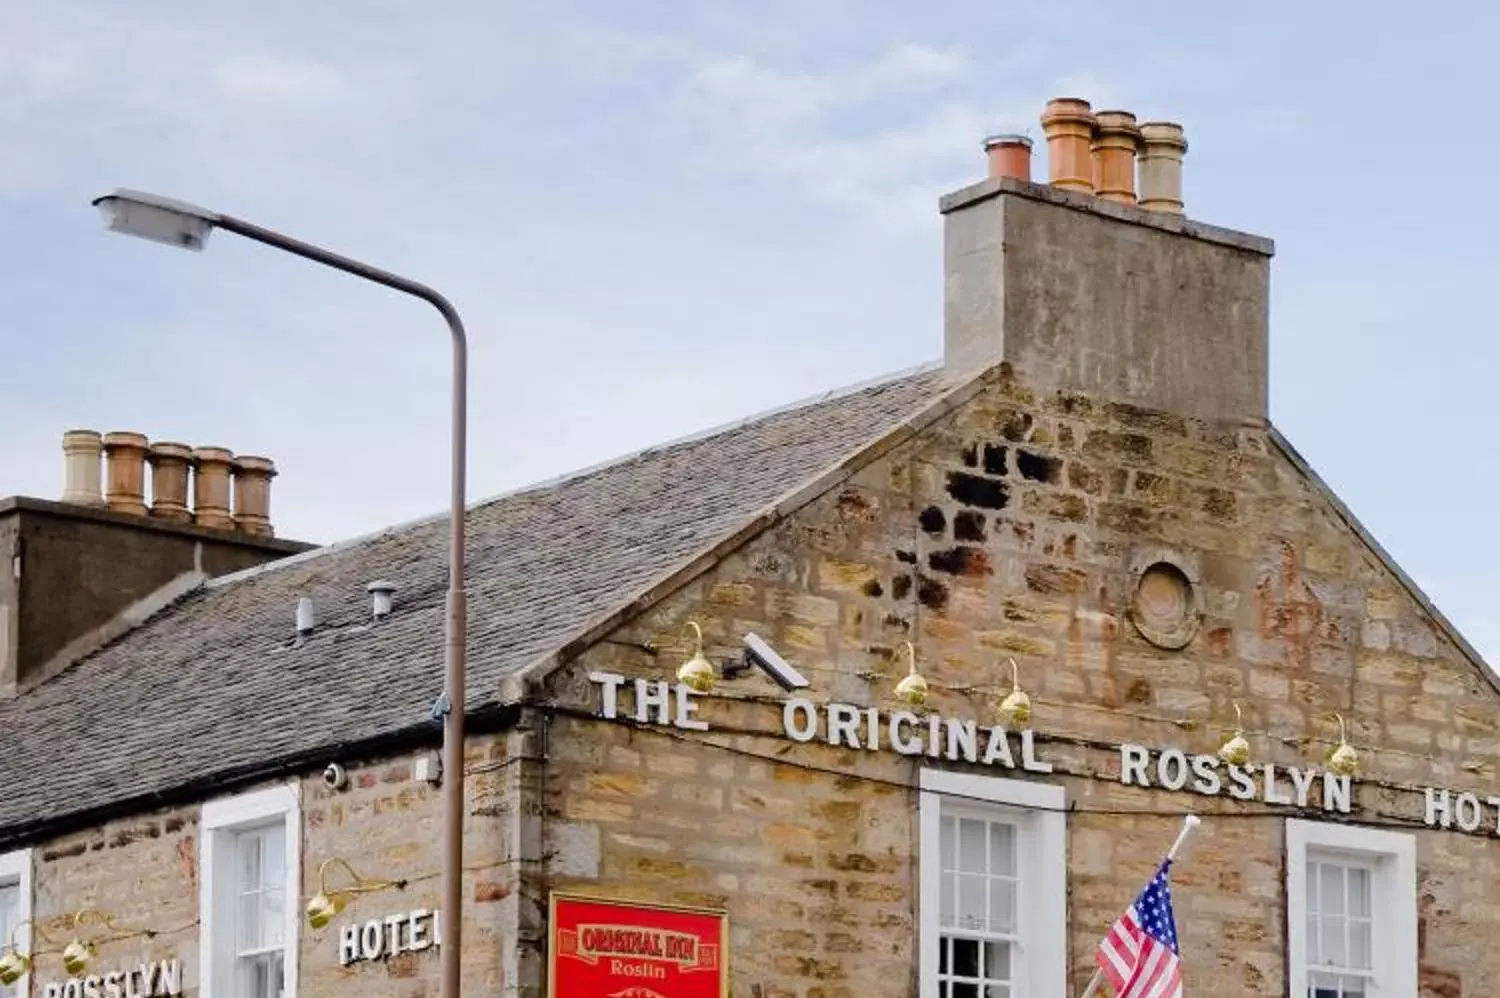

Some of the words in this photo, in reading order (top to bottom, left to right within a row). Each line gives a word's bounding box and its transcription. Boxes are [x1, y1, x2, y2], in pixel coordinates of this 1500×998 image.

[589, 671, 709, 731] THE
[782, 697, 1053, 773] ORIGINAL
[1120, 743, 1352, 813] ROSSLYN
[611, 959, 666, 979] Roslin
